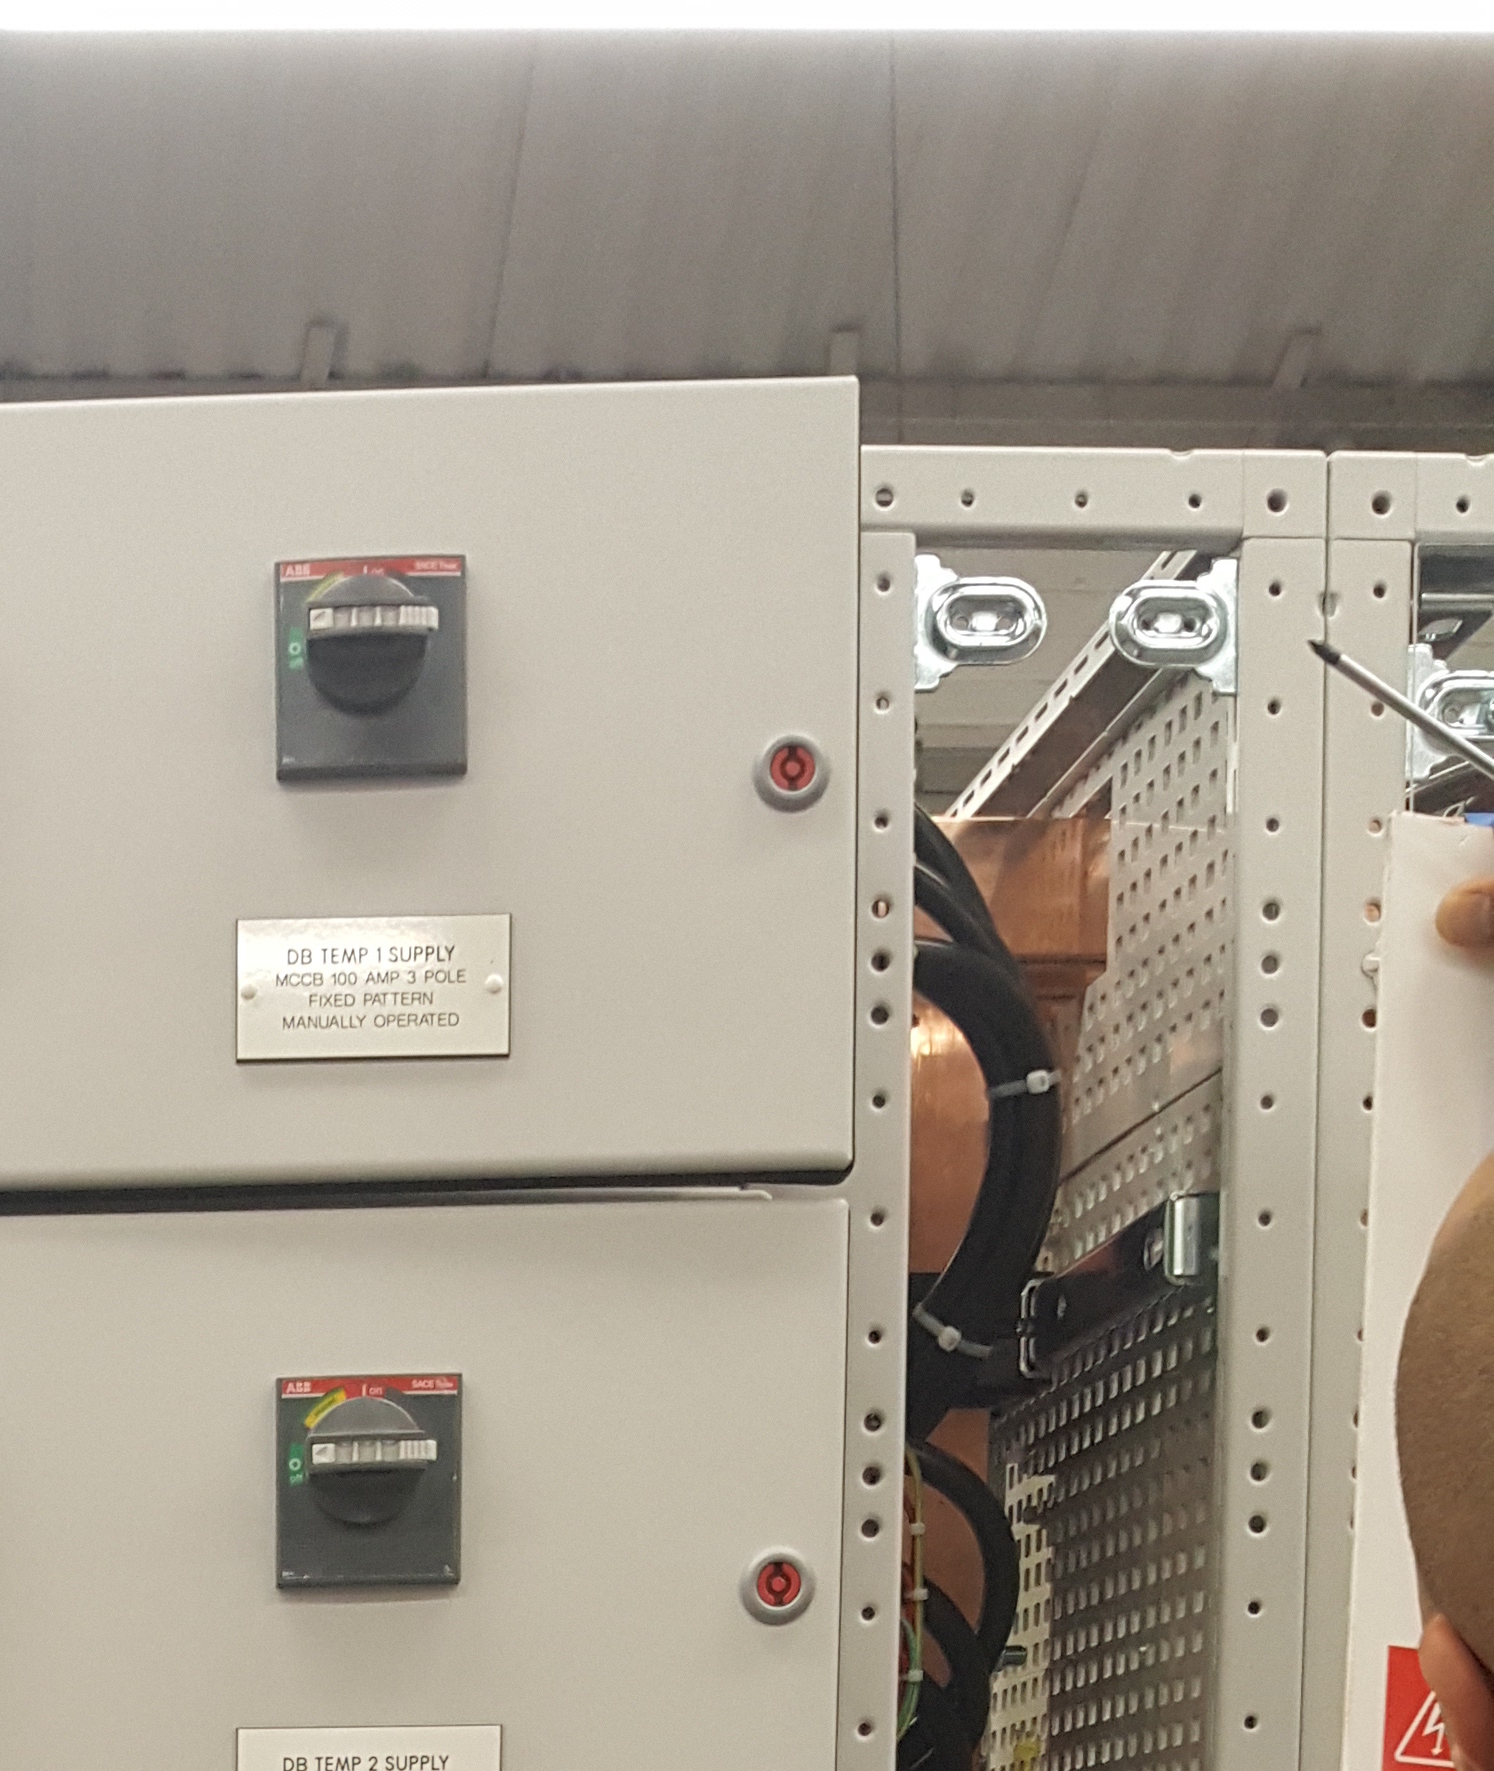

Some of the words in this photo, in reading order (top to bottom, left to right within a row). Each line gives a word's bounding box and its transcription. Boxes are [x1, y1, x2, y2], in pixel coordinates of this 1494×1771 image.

[287, 949, 312, 965] DB
[322, 948, 368, 964] TEMP
[377, 947, 382, 963] 1
[389, 946, 455, 963] SUPPLY
[276, 973, 323, 987] MCCB
[332, 972, 357, 985] 100
[366, 972, 399, 985] AMP
[407, 971, 416, 984] 3
[425, 970, 466, 983] POLE
[309, 994, 355, 1007] FIXED
[363, 992, 433, 1007] PATTERN
[282, 1016, 366, 1030] MANUALLY
[374, 1013, 459, 1027] OPERATED
[315, 1757, 361, 1771] TEMP
[368, 1756, 378, 1771] 2
[385, 1755, 449, 1771] SUPPLY
